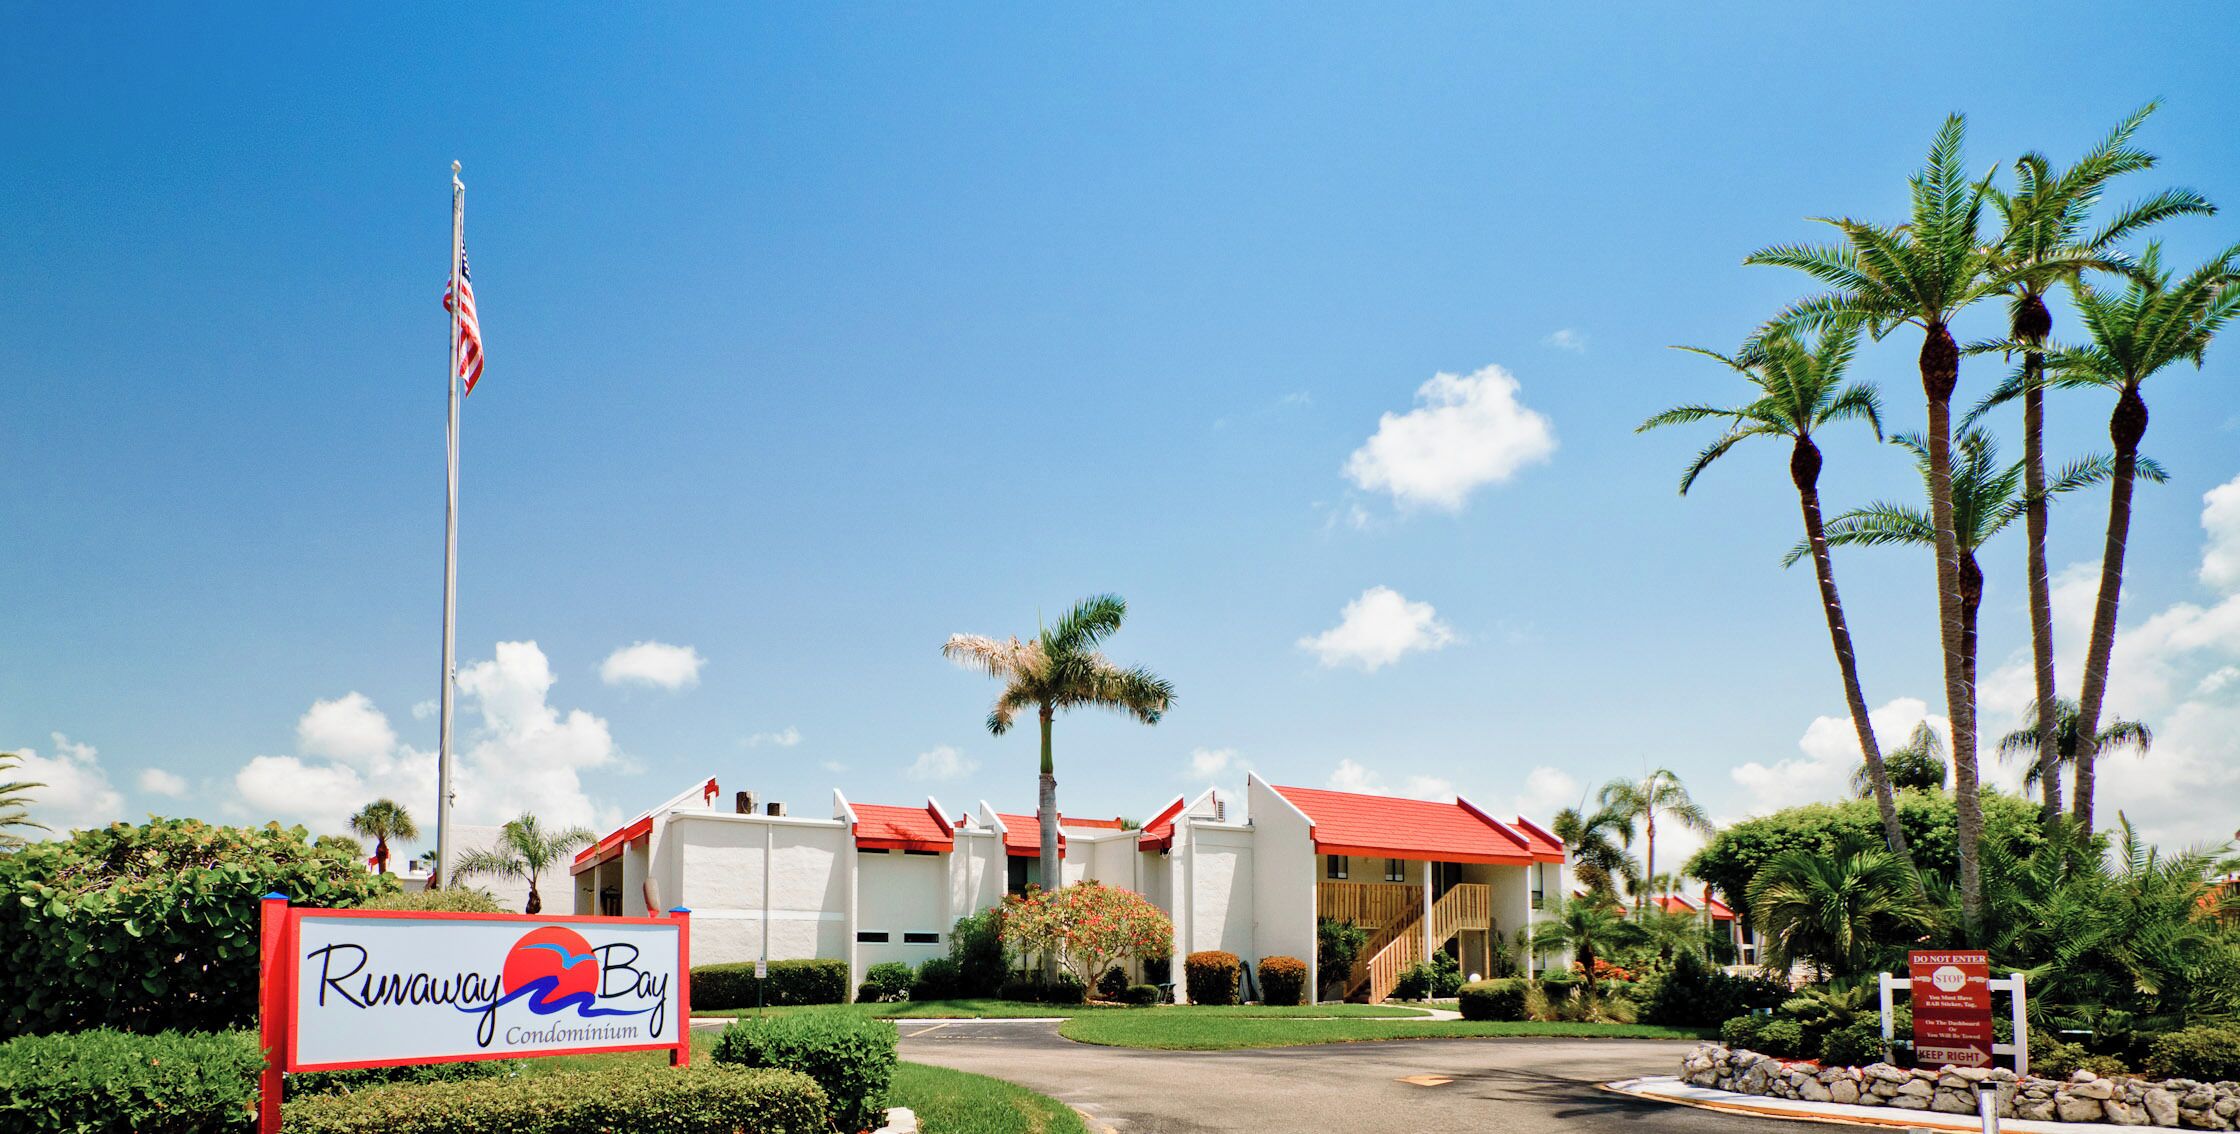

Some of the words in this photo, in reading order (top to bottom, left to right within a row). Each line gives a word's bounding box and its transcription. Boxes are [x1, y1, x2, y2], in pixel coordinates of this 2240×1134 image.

[1935, 975, 1963, 983] STOP
[307, 943, 501, 1048] Runaway
[591, 943, 668, 1038] Bay
[506, 1020, 638, 1046] Condominium
[1919, 1050, 1944, 1060] KEEP
[1947, 1051, 1980, 1062] RIGHT
